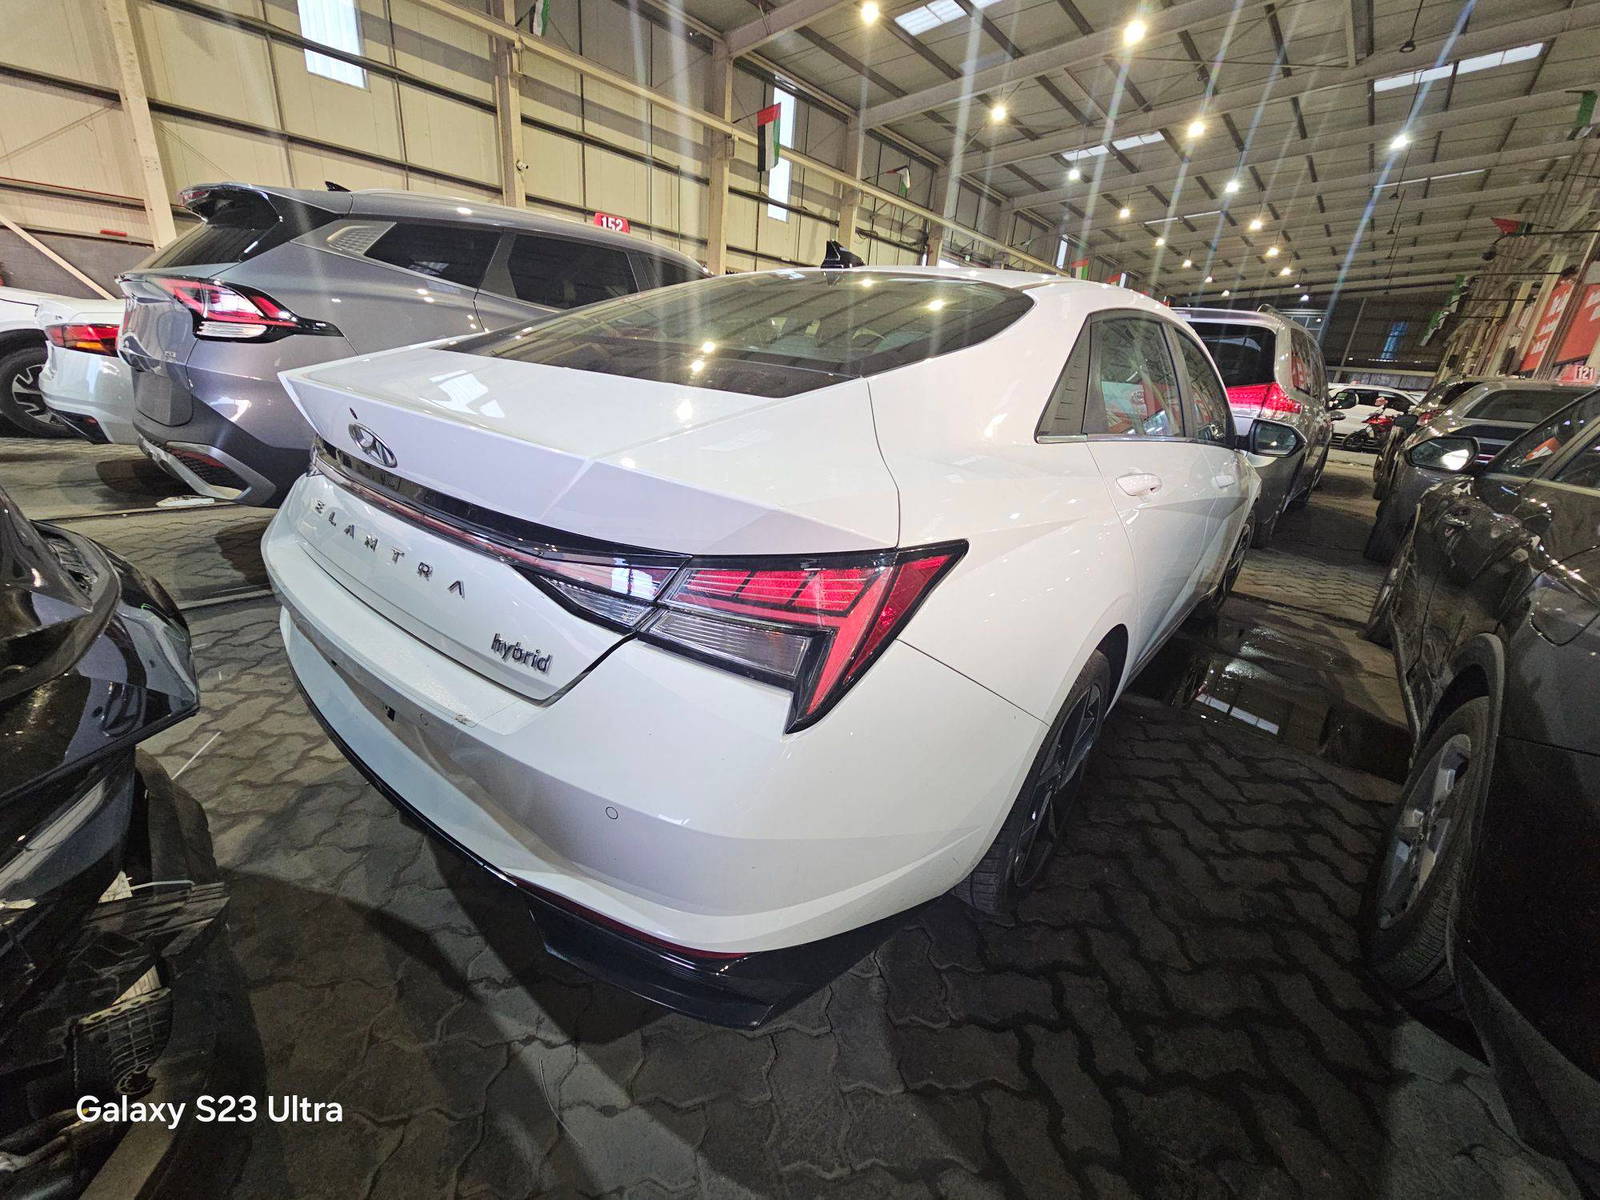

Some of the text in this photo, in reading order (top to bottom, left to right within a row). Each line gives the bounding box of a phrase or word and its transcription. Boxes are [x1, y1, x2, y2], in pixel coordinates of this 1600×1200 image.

[601, 216, 623, 232] 152
[314, 499, 466, 600] ELANTRA
[491, 632, 552, 674] hybrid
